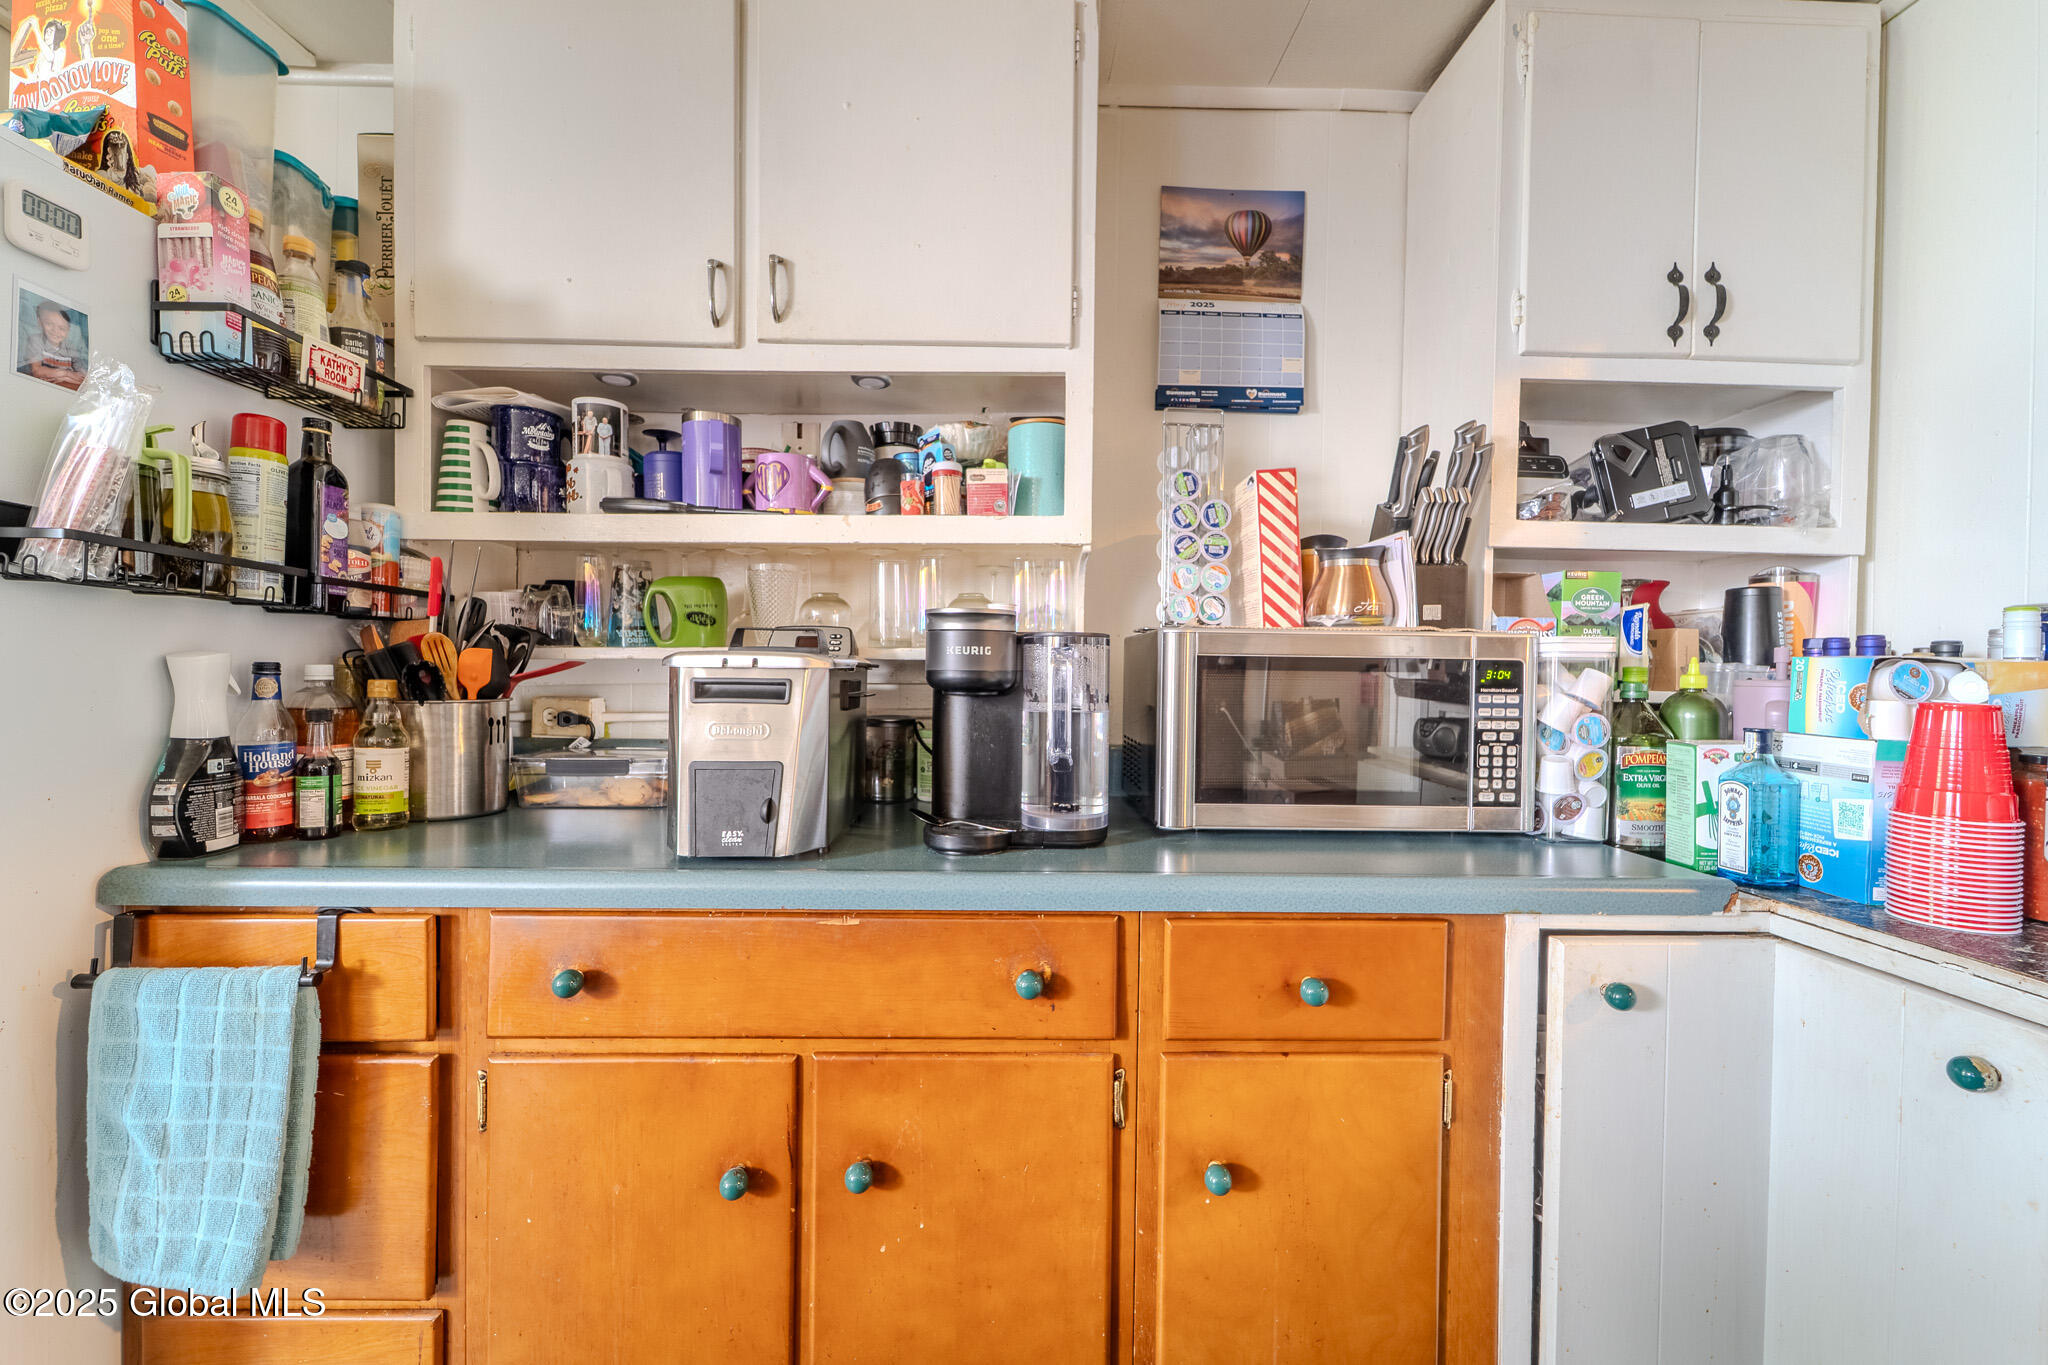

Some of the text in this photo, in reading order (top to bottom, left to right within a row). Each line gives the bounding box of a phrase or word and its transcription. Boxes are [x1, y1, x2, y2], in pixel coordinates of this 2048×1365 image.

[145, 47, 186, 79] Puffs
[58, 62, 91, 94] YOU
[93, 60, 131, 88] LOVE
[225, 192, 238, 207] 24
[169, 288, 182, 299] 24
[320, 355, 354, 377] KATHY'S
[324, 368, 348, 385] ROOM
[1633, 611, 1643, 640] Reynolds
[1777, 611, 1786, 647] STARB
[946, 645, 992, 656] KEURIG
[1796, 658, 1805, 671] 20
[1486, 670, 1511, 680] 3:04
[1836, 680, 1847, 714] ICED
[243, 749, 295, 763] Holland
[249, 759, 291, 773] House
[357, 773, 393, 782] mizkan
[1623, 774, 1667, 782] EXTRA VIRG
[1631, 824, 1664, 832] SMOOTH
[1815, 845, 1840, 858] ICED
